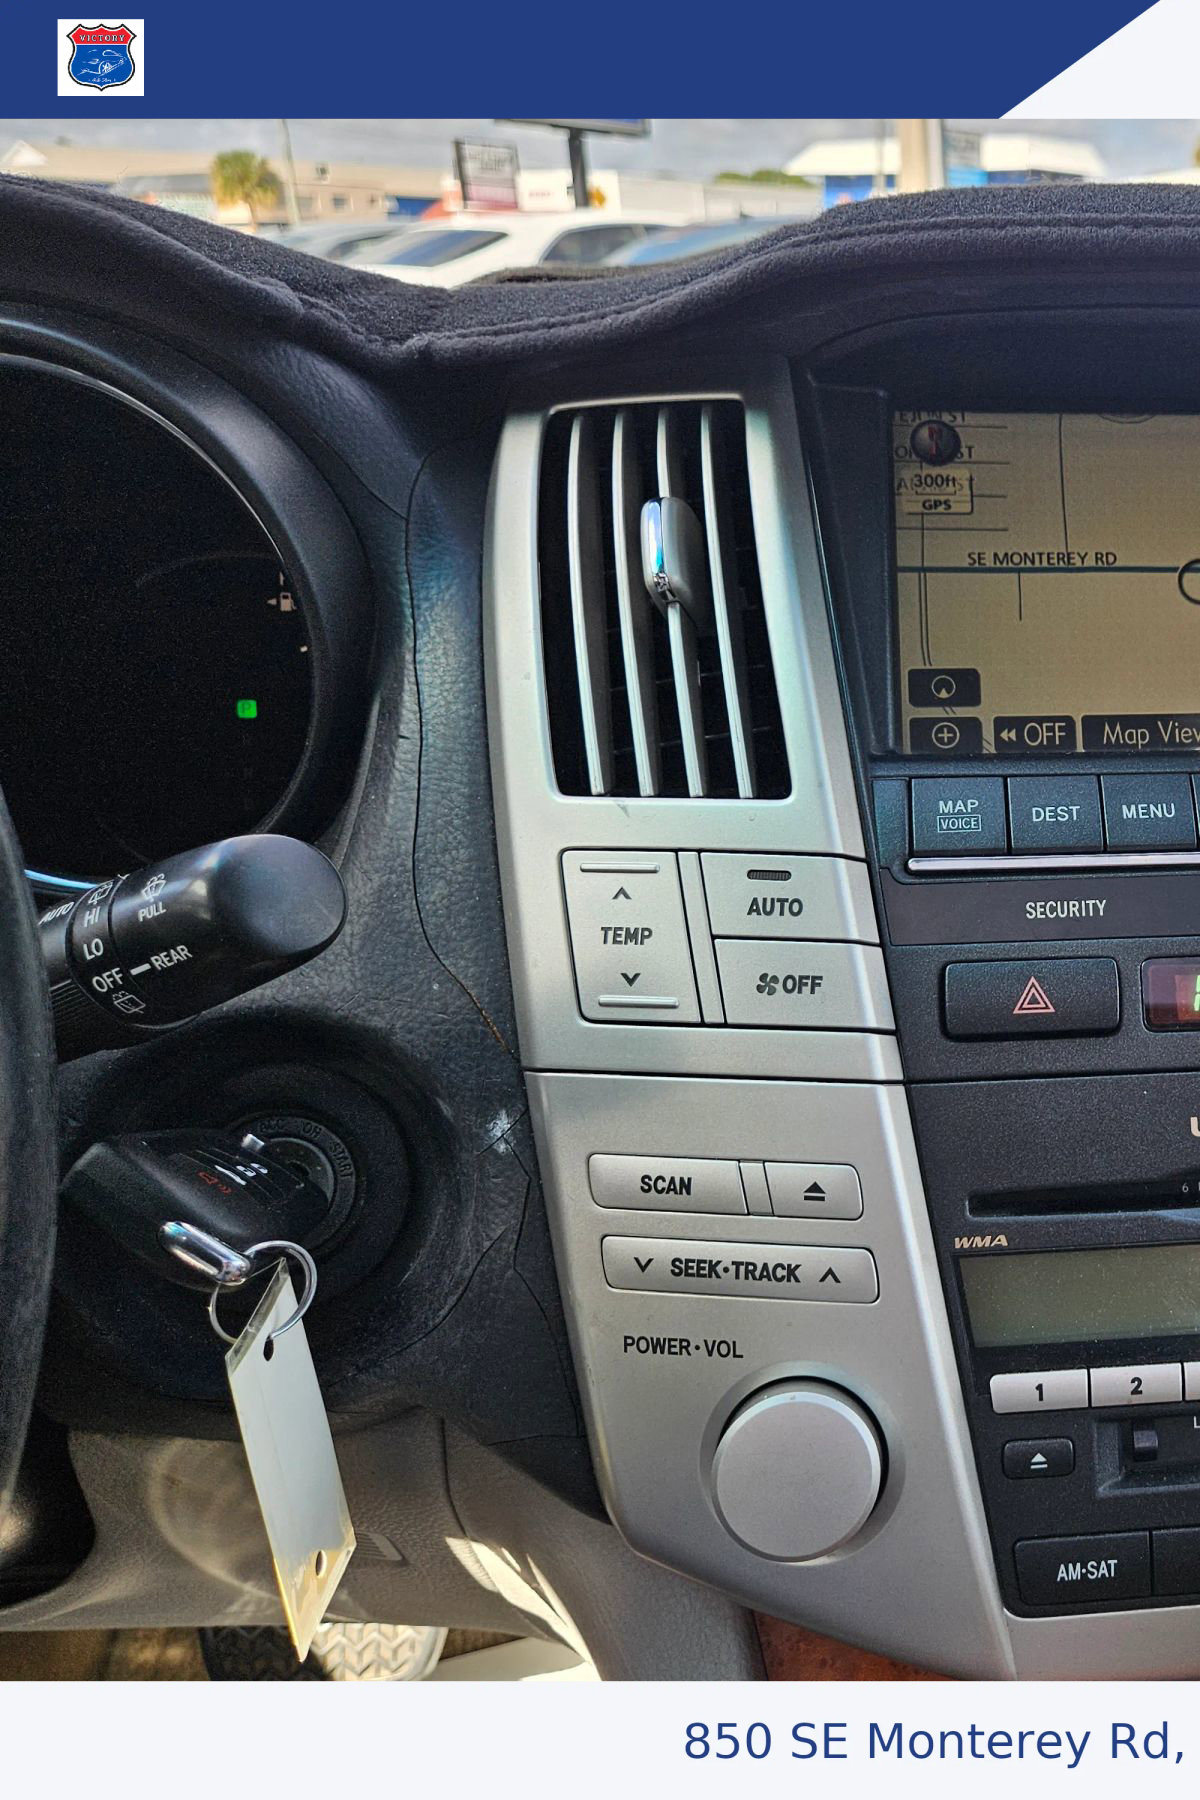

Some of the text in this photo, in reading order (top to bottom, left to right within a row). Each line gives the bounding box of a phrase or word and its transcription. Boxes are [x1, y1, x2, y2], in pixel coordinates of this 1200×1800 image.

[913, 473, 956, 488] 300ft
[922, 498, 952, 511] GPS
[967, 551, 1117, 567] SE MONTEREY RD
[1024, 722, 1066, 746] OFF
[1103, 722, 1149, 749] Map
[938, 799, 979, 814] MAP
[1031, 805, 1081, 822] DEST
[1121, 803, 1176, 819] MENU
[940, 816, 979, 830] VOICE
[38, 901, 75, 926] AUTO
[138, 901, 167, 922] PULL
[746, 896, 804, 917] AUTO
[1025, 899, 1107, 920] SECURITY
[84, 908, 100, 927] HI
[600, 926, 653, 946] TEMP
[83, 938, 104, 961] LO
[92, 944, 193, 993] OFF REAR
[782, 974, 824, 995] OFF
[640, 1174, 692, 1196] SCAN
[1182, 1183, 1189, 1193] 6
[954, 1234, 1009, 1249] WMA
[1035, 1383, 1044, 1402] 1
[1130, 1377, 1143, 1396] 2
